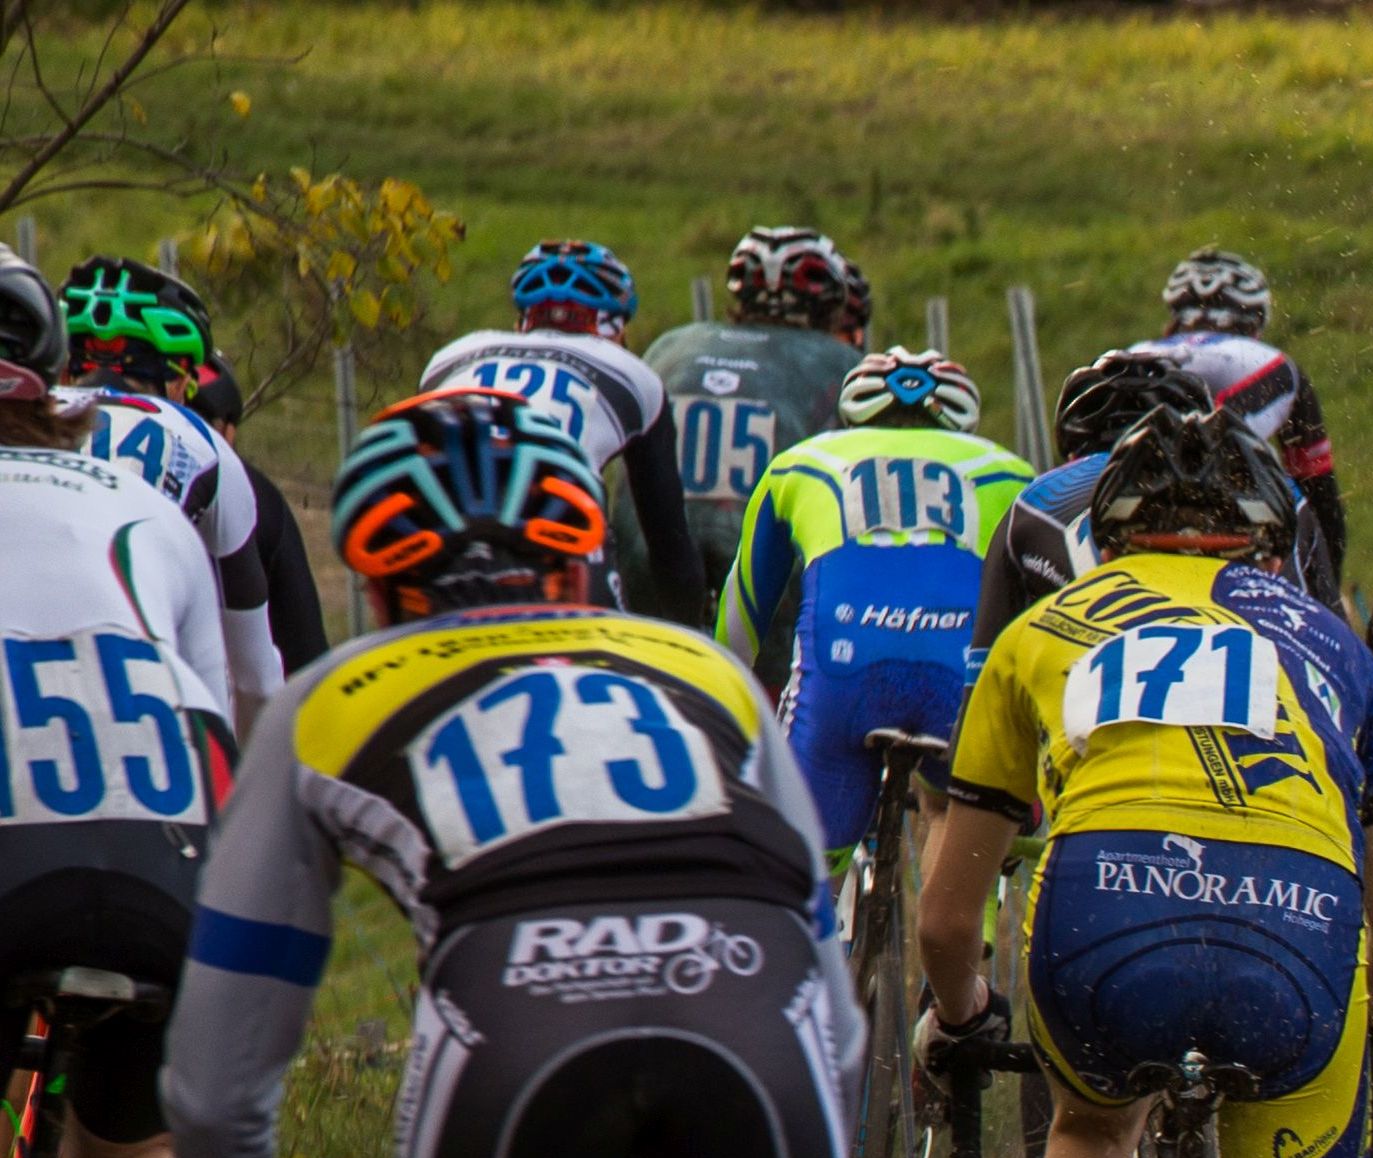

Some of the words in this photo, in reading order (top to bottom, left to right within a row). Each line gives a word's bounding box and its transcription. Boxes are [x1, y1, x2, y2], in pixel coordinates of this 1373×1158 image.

[850, 457, 966, 537] 113
[860, 603, 971, 634] Häfner
[1089, 627, 1254, 727] 171
[427, 670, 698, 846] 173
[1094, 860, 1340, 922] PANORAMIC
[507, 912, 710, 965] RAD
[502, 956, 663, 988] DOKTOR
